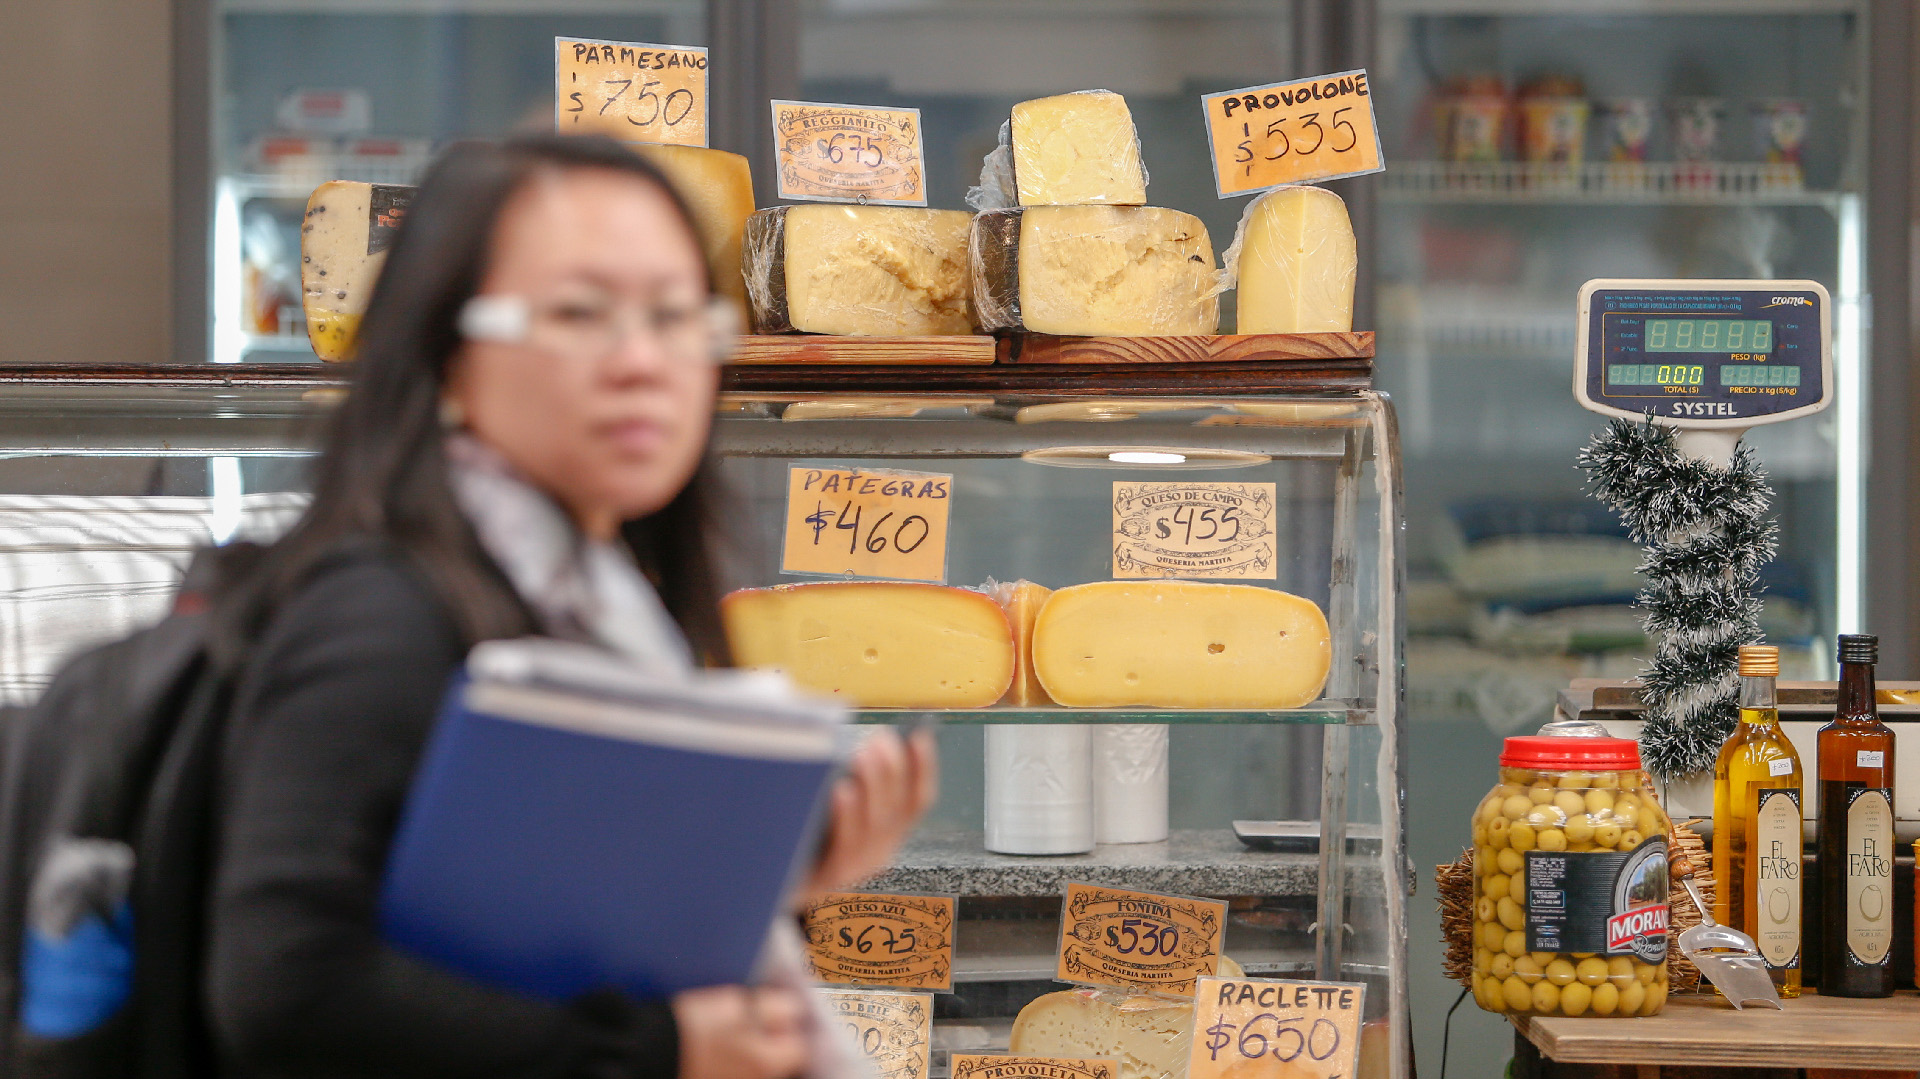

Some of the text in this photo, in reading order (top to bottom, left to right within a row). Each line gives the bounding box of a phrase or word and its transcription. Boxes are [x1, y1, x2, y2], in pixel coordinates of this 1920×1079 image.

[572, 43, 708, 70] PARMESANO
[1222, 73, 1369, 118] PROVOLONE
[803, 116, 887, 132] REGGIANITO
[816, 133, 883, 168] $675
[818, 175, 885, 187] QUESERIA MARTITA
[1771, 296, 1805, 307] croma
[1731, 353, 1766, 362] PESO (kg)
[1657, 365, 1703, 384] 0.00
[1663, 385, 1687, 393] TOTAL
[1729, 386, 1757, 394] PRECIO
[1671, 402, 1738, 416] SYSTEL
[804, 470, 948, 499] PATEGRAS
[1141, 491, 1243, 508] QUESO DE CAMPO
[805, 500, 930, 555] $460
[1155, 505, 1241, 545] $455
[1156, 556, 1232, 567] QUESERIA MARTITA
[1771, 840, 1787, 860] EL
[1863, 838, 1880, 858] EL
[1759, 856, 1799, 880] FARO
[1849, 853, 1891, 878] FARO
[839, 903, 907, 917] QUESO AZUL
[1117, 901, 1173, 919] FONTINA
[838, 924, 916, 954] $675
[1103, 919, 1179, 957] $530
[837, 963, 911, 975] QUESERIA MARTITA
[1102, 962, 1174, 979] QUESERIA MARTITA
[1218, 982, 1354, 1010] RACLETTE
[857, 1003, 890, 1016] BRIE
[1205, 1013, 1341, 1063] $650
[984, 1065, 1077, 1079] PROVOLETA
